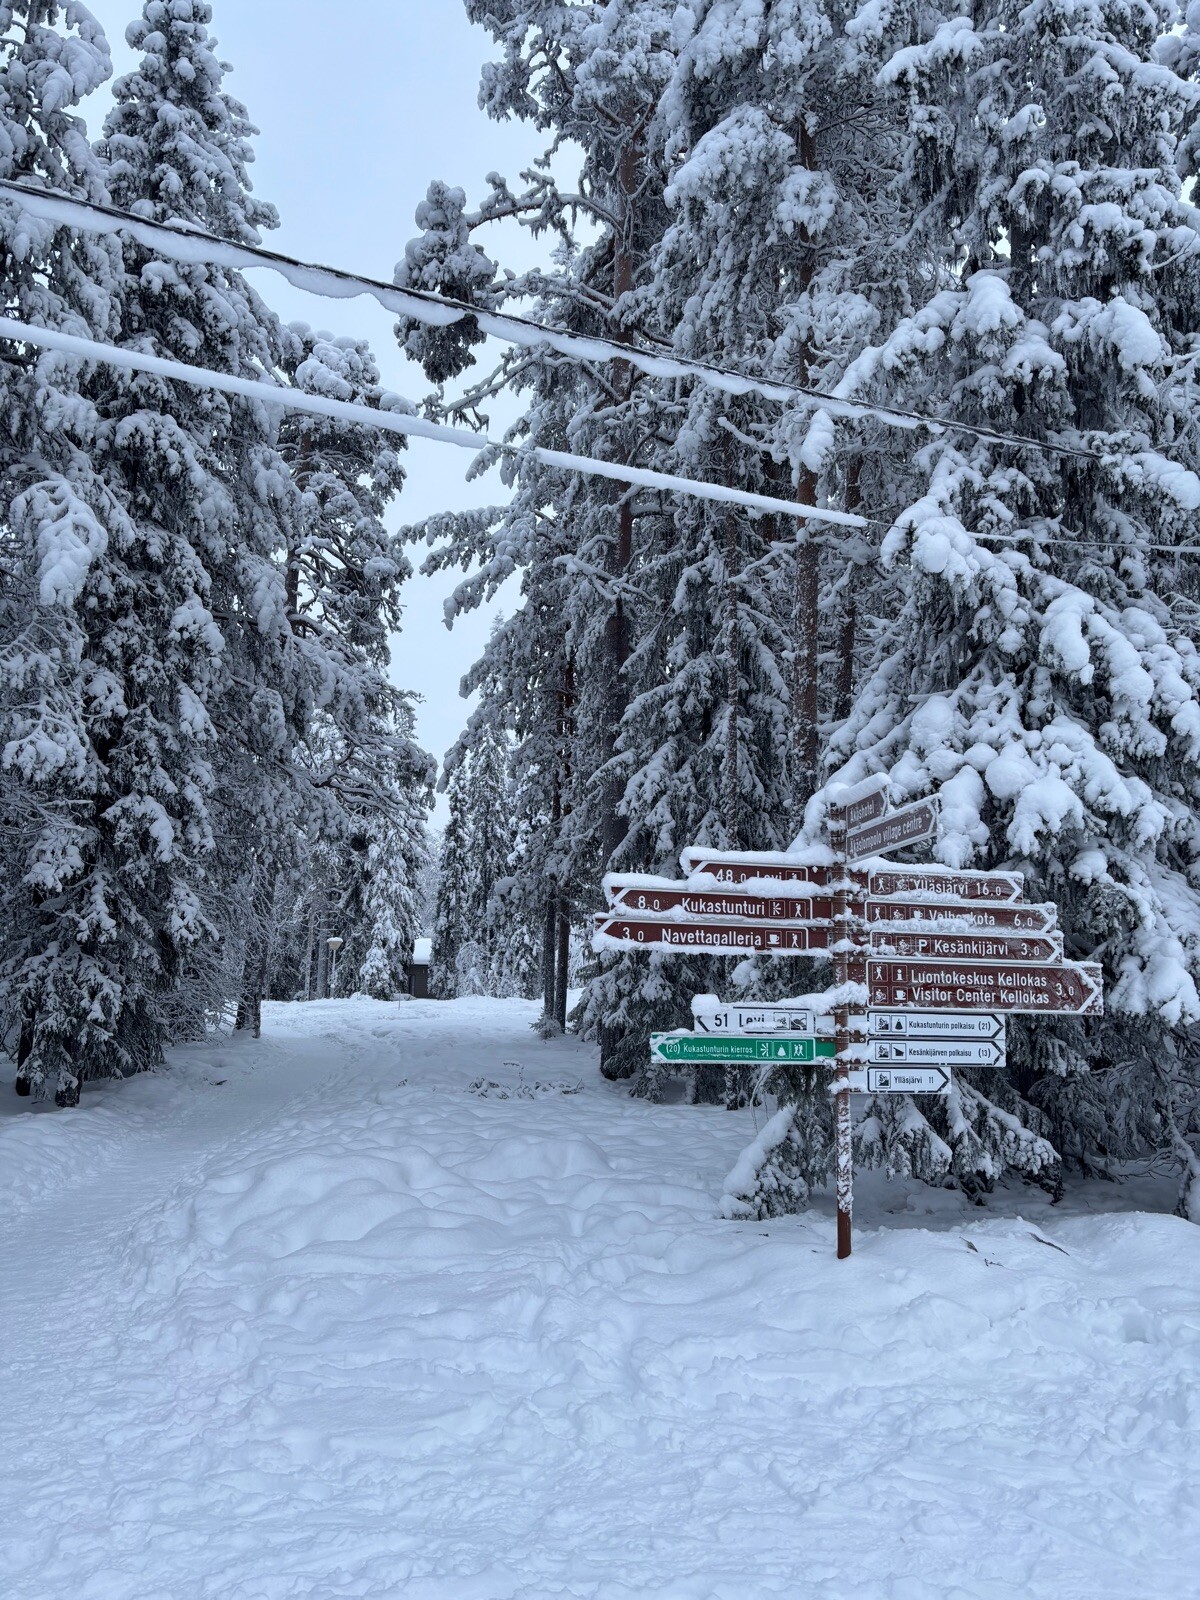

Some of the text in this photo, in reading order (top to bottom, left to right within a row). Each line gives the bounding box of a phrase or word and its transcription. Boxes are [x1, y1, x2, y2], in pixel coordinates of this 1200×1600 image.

[883, 825, 902, 841] village
[902, 815, 922, 833] centre
[681, 897, 765, 915] Kukastunturi
[928, 909, 996, 926] Velhokota
[661, 927, 762, 946] Navettagalleria
[934, 940, 1009, 957] Kesänkijärvi
[911, 969, 1047, 987] Luontokeskus Kellokas
[912, 986, 1050, 1004] Visitor Center Kellokas
[714, 1012, 728, 1027] 51
[908, 1020, 991, 1031] Kukastunturin polkaisu (21)
[666, 1043, 753, 1055] (20) Kukastunturin kierros
[908, 1047, 991, 1058] Kesänkijärven polkaisu (13)
[894, 1076, 934, 1085] Ylläsjärvi 11
